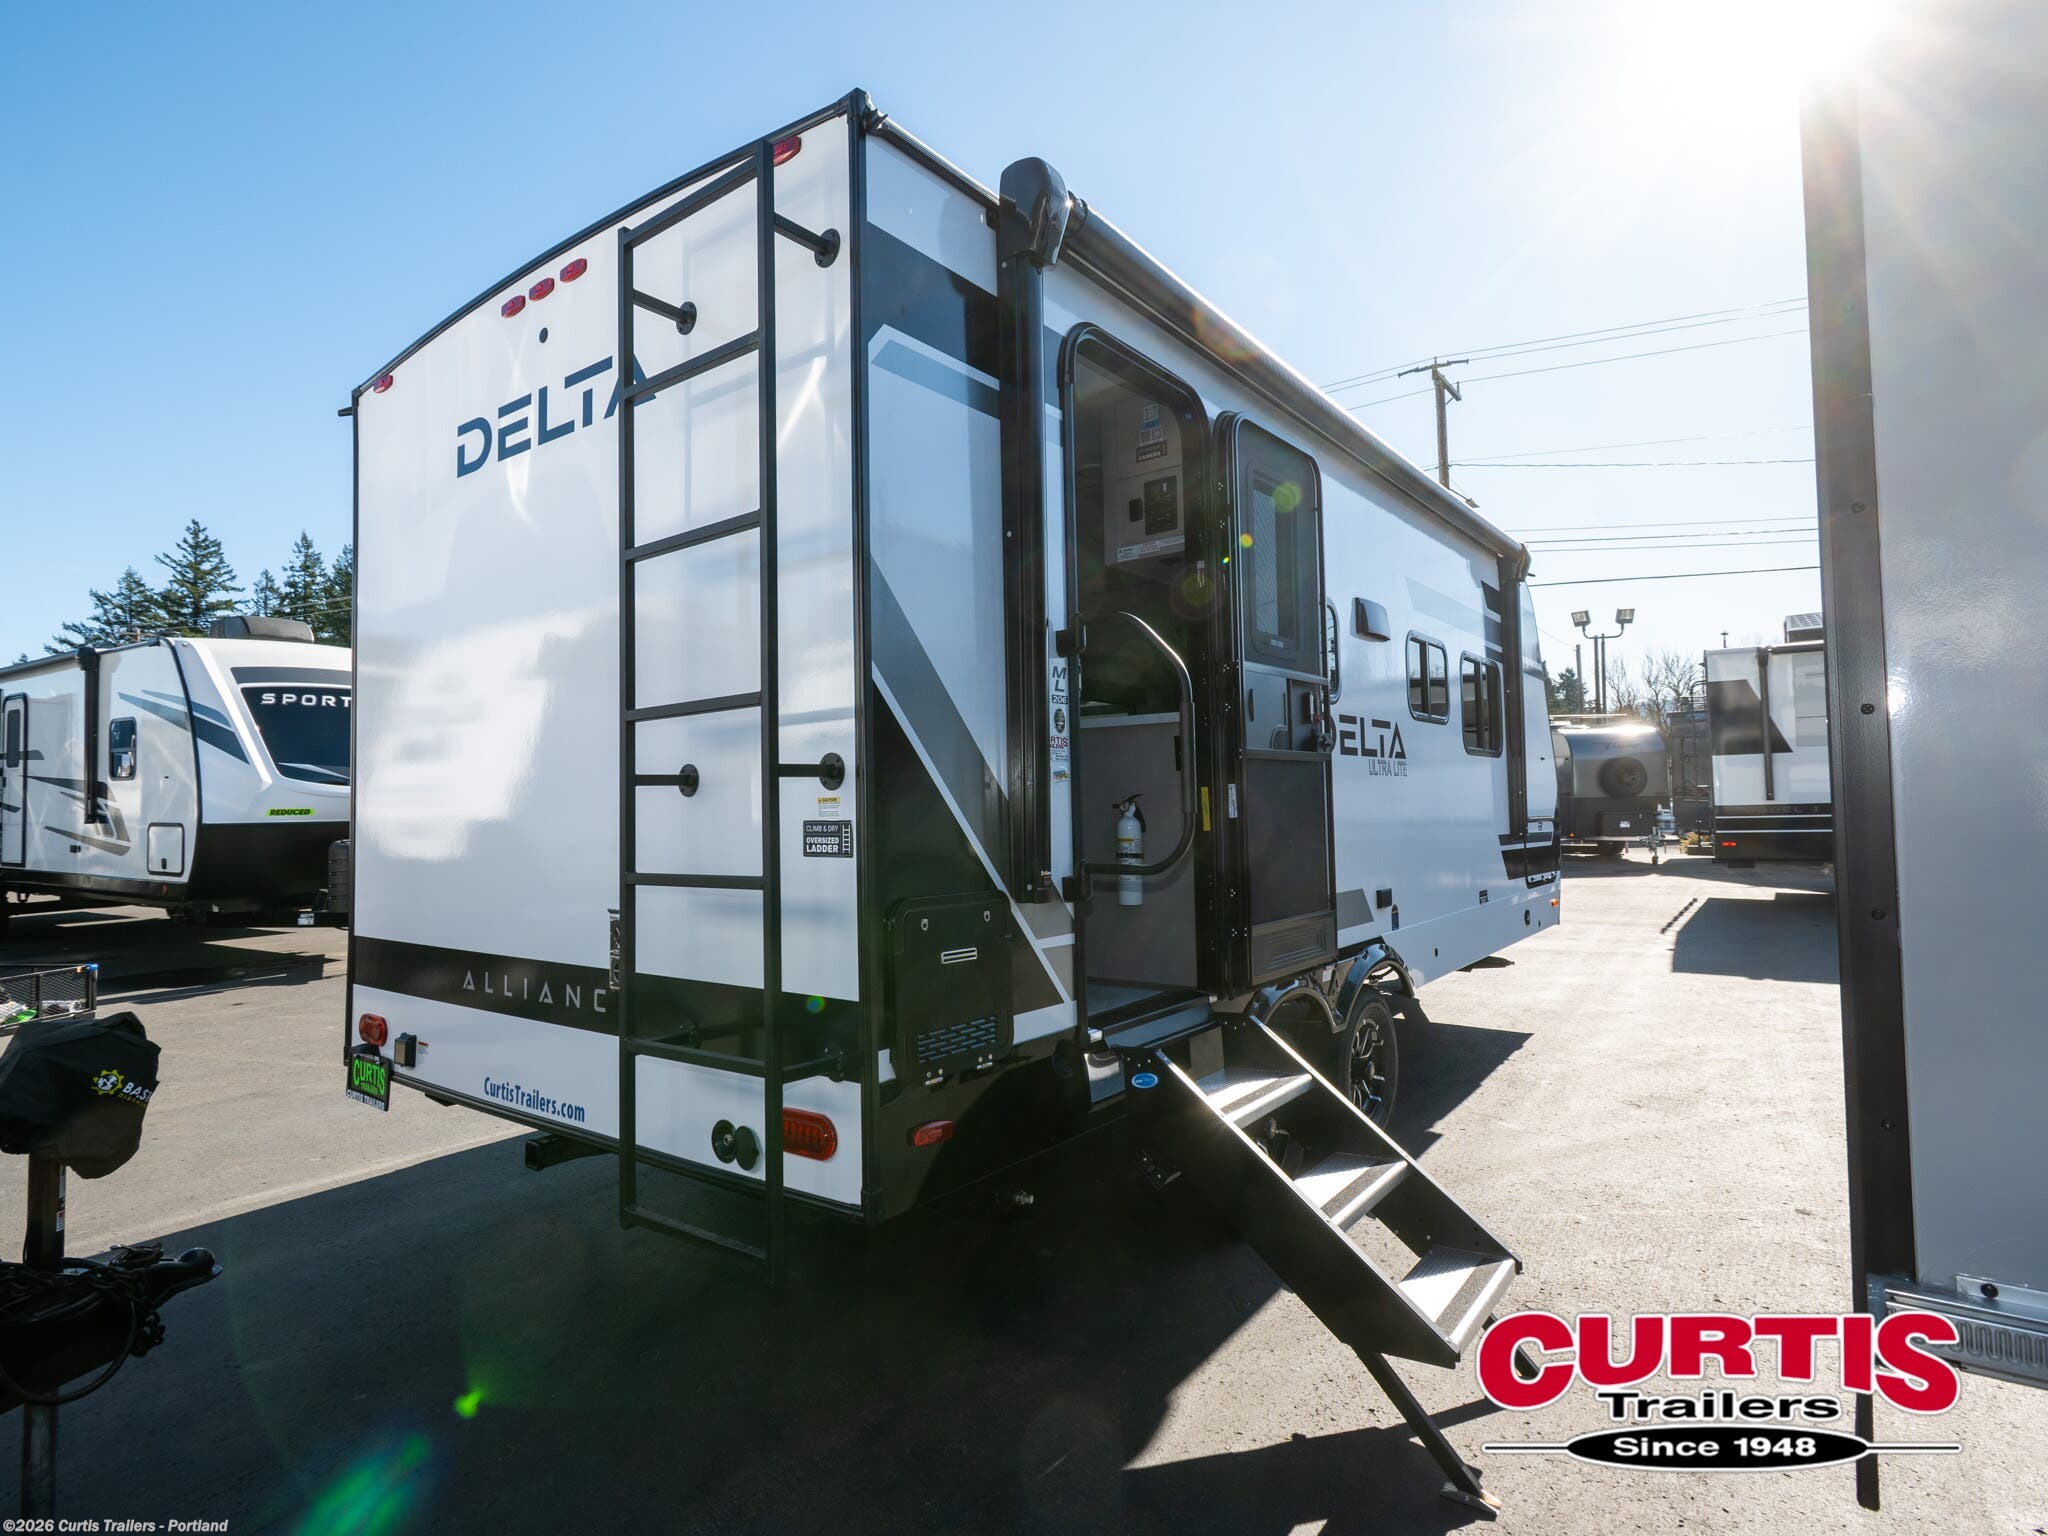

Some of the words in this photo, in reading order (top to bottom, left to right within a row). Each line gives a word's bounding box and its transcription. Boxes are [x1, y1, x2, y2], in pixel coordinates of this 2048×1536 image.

[457, 353, 656, 478] DELTA
[1331, 714, 1406, 759] ELTA
[1368, 759, 1392, 776] ULTRA
[1394, 761, 1407, 776] LITE
[806, 845, 839, 853] LADDER
[462, 969, 606, 1013] ALLIANC
[353, 1058, 386, 1095] CURTIS
[484, 1077, 585, 1123] CurtisTrailers.com
